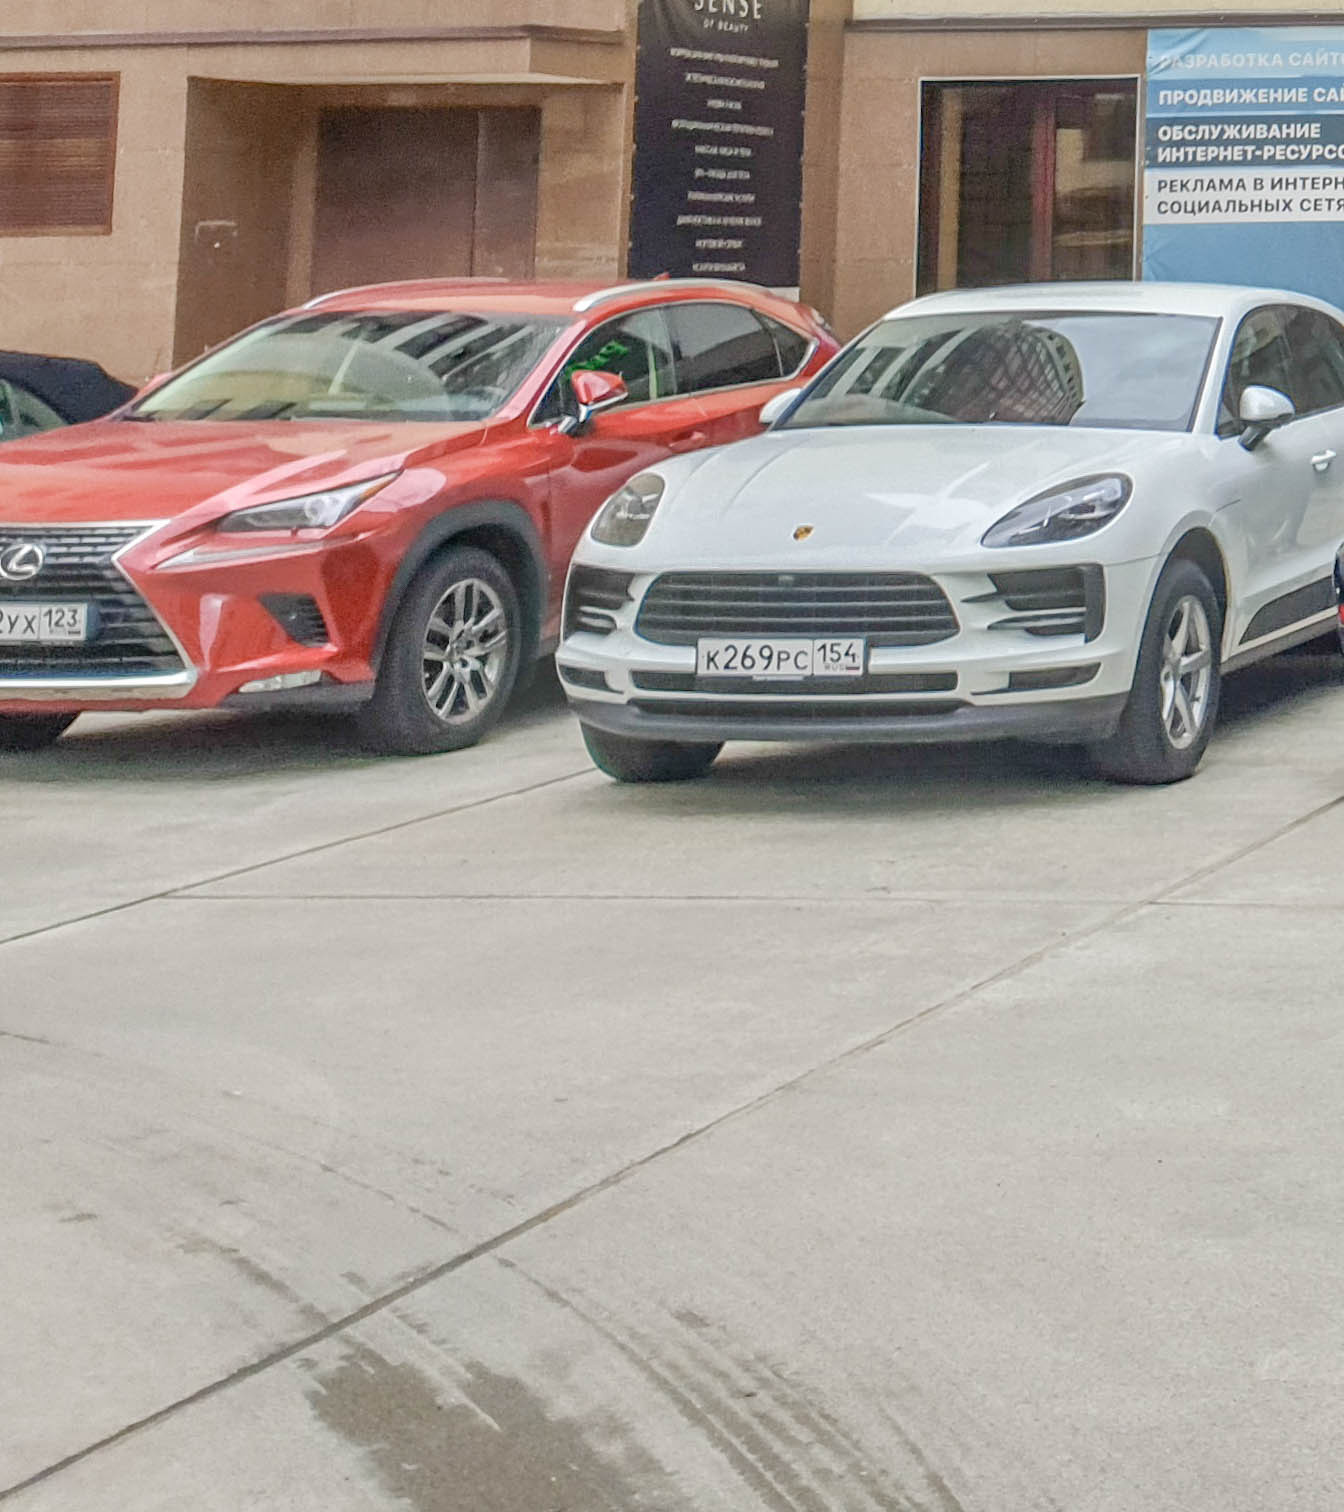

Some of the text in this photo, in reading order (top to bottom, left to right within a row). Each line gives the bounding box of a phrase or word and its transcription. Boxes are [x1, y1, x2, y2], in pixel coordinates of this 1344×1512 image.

[1160, 52, 1284, 70] РАЗРАБОТКА
[1158, 87, 1308, 107] ПРОДВИЖЕНИЕ
[1157, 123, 1322, 142] ОБСЛУЖИВАНИЕ
[1157, 178, 1248, 194] РЕКЛАМА
[1252, 177, 1265, 192] В
[1156, 199, 1293, 216] СОЦИАЛЬНЫХ
[43, 608, 79, 629] 123
[706, 642, 857, 671] К269РС 154
